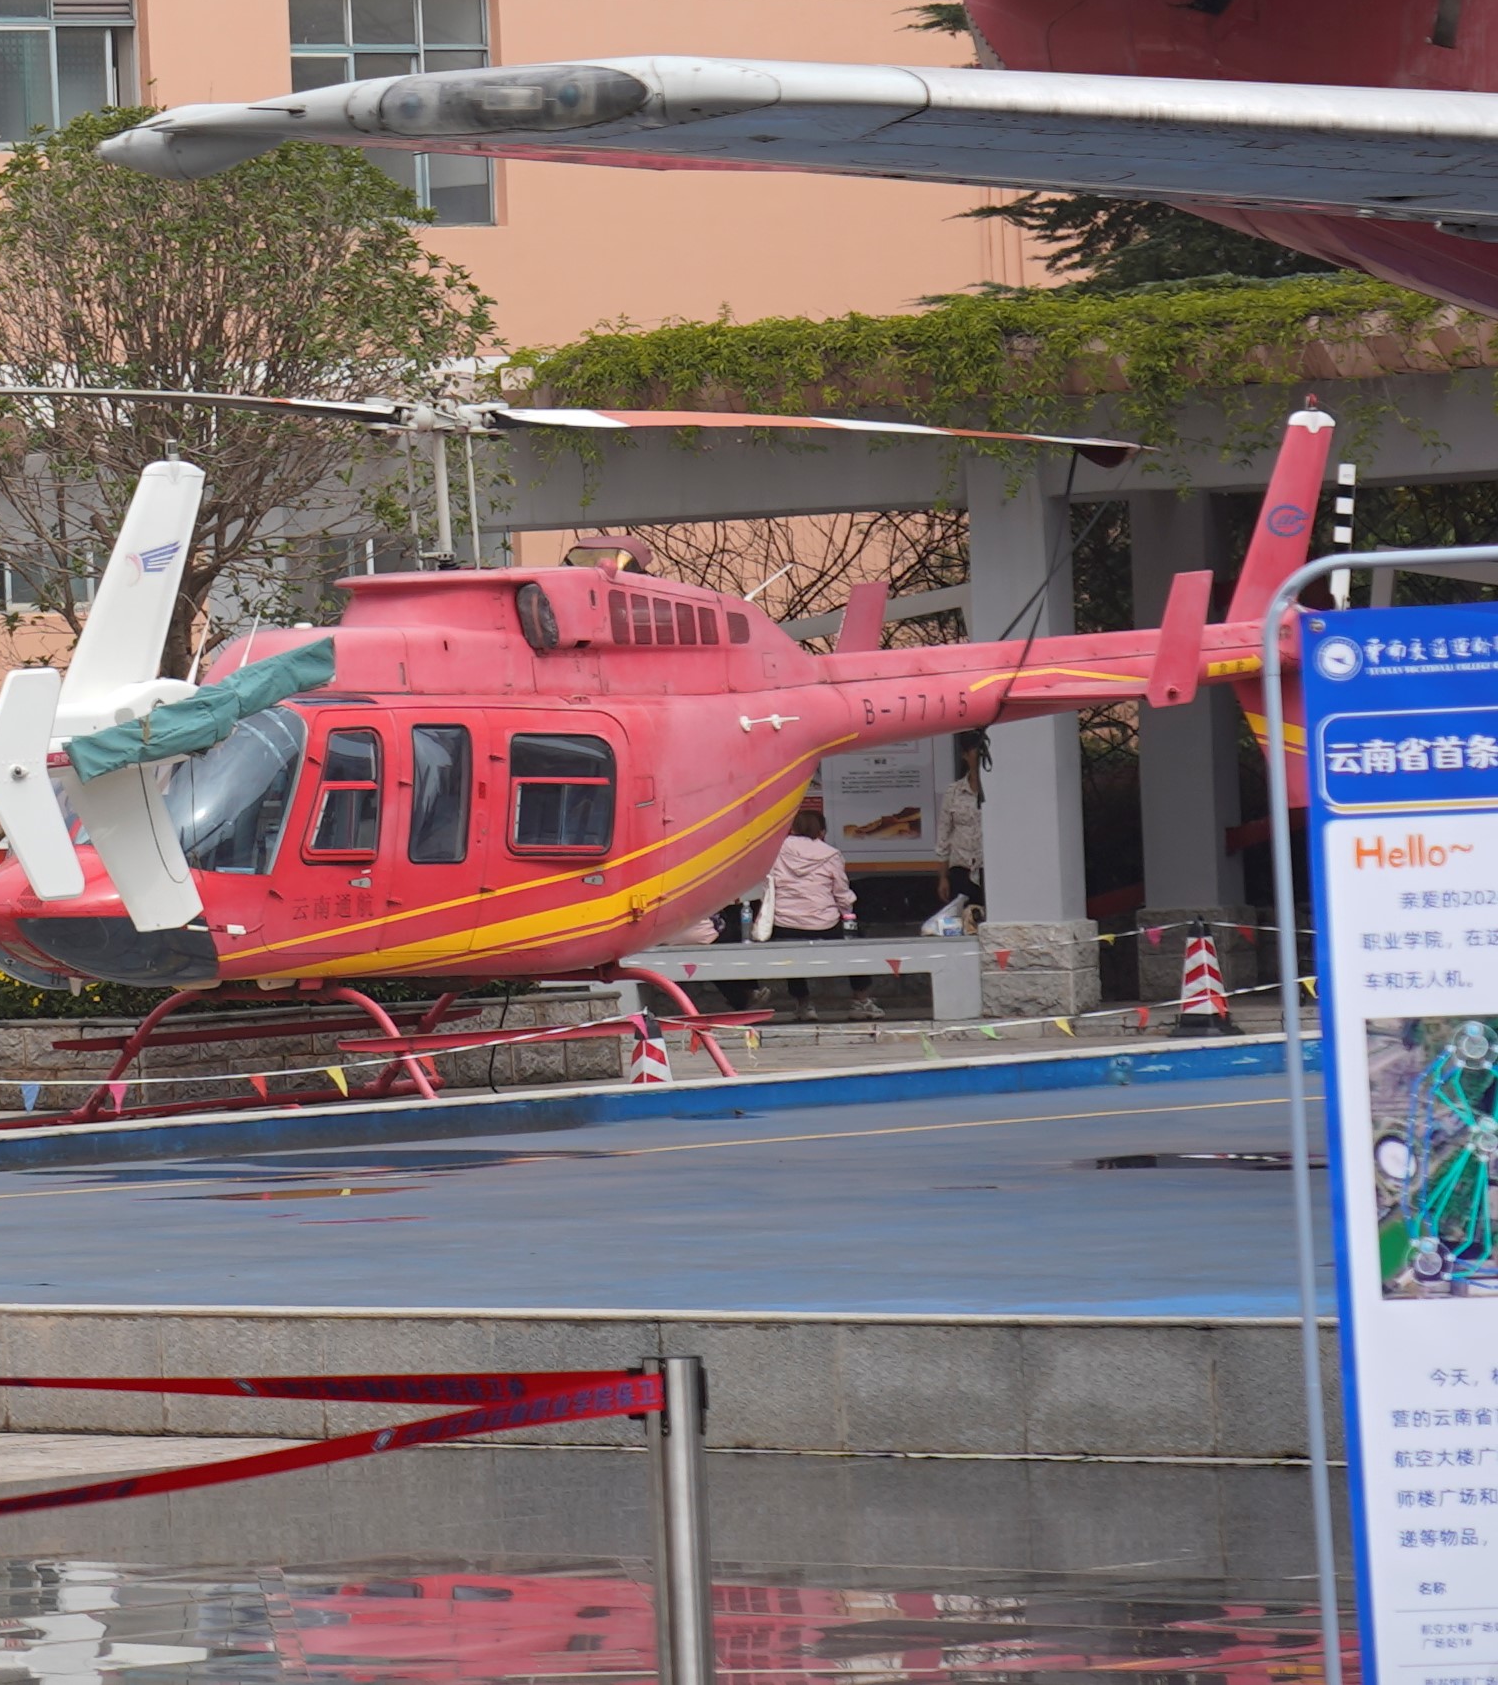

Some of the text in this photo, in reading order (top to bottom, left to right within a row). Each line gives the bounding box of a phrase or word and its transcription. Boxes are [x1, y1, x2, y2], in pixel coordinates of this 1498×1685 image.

[863, 691, 968, 725] B-7715
[1326, 735, 1498, 774] 云南省首条
[292, 893, 374, 920] 云南通航
[1430, 1368, 1498, 1386] 今天，
[1391, 1407, 1498, 1428] 营的云南省
[1419, 1582, 1447, 1595] 名称
